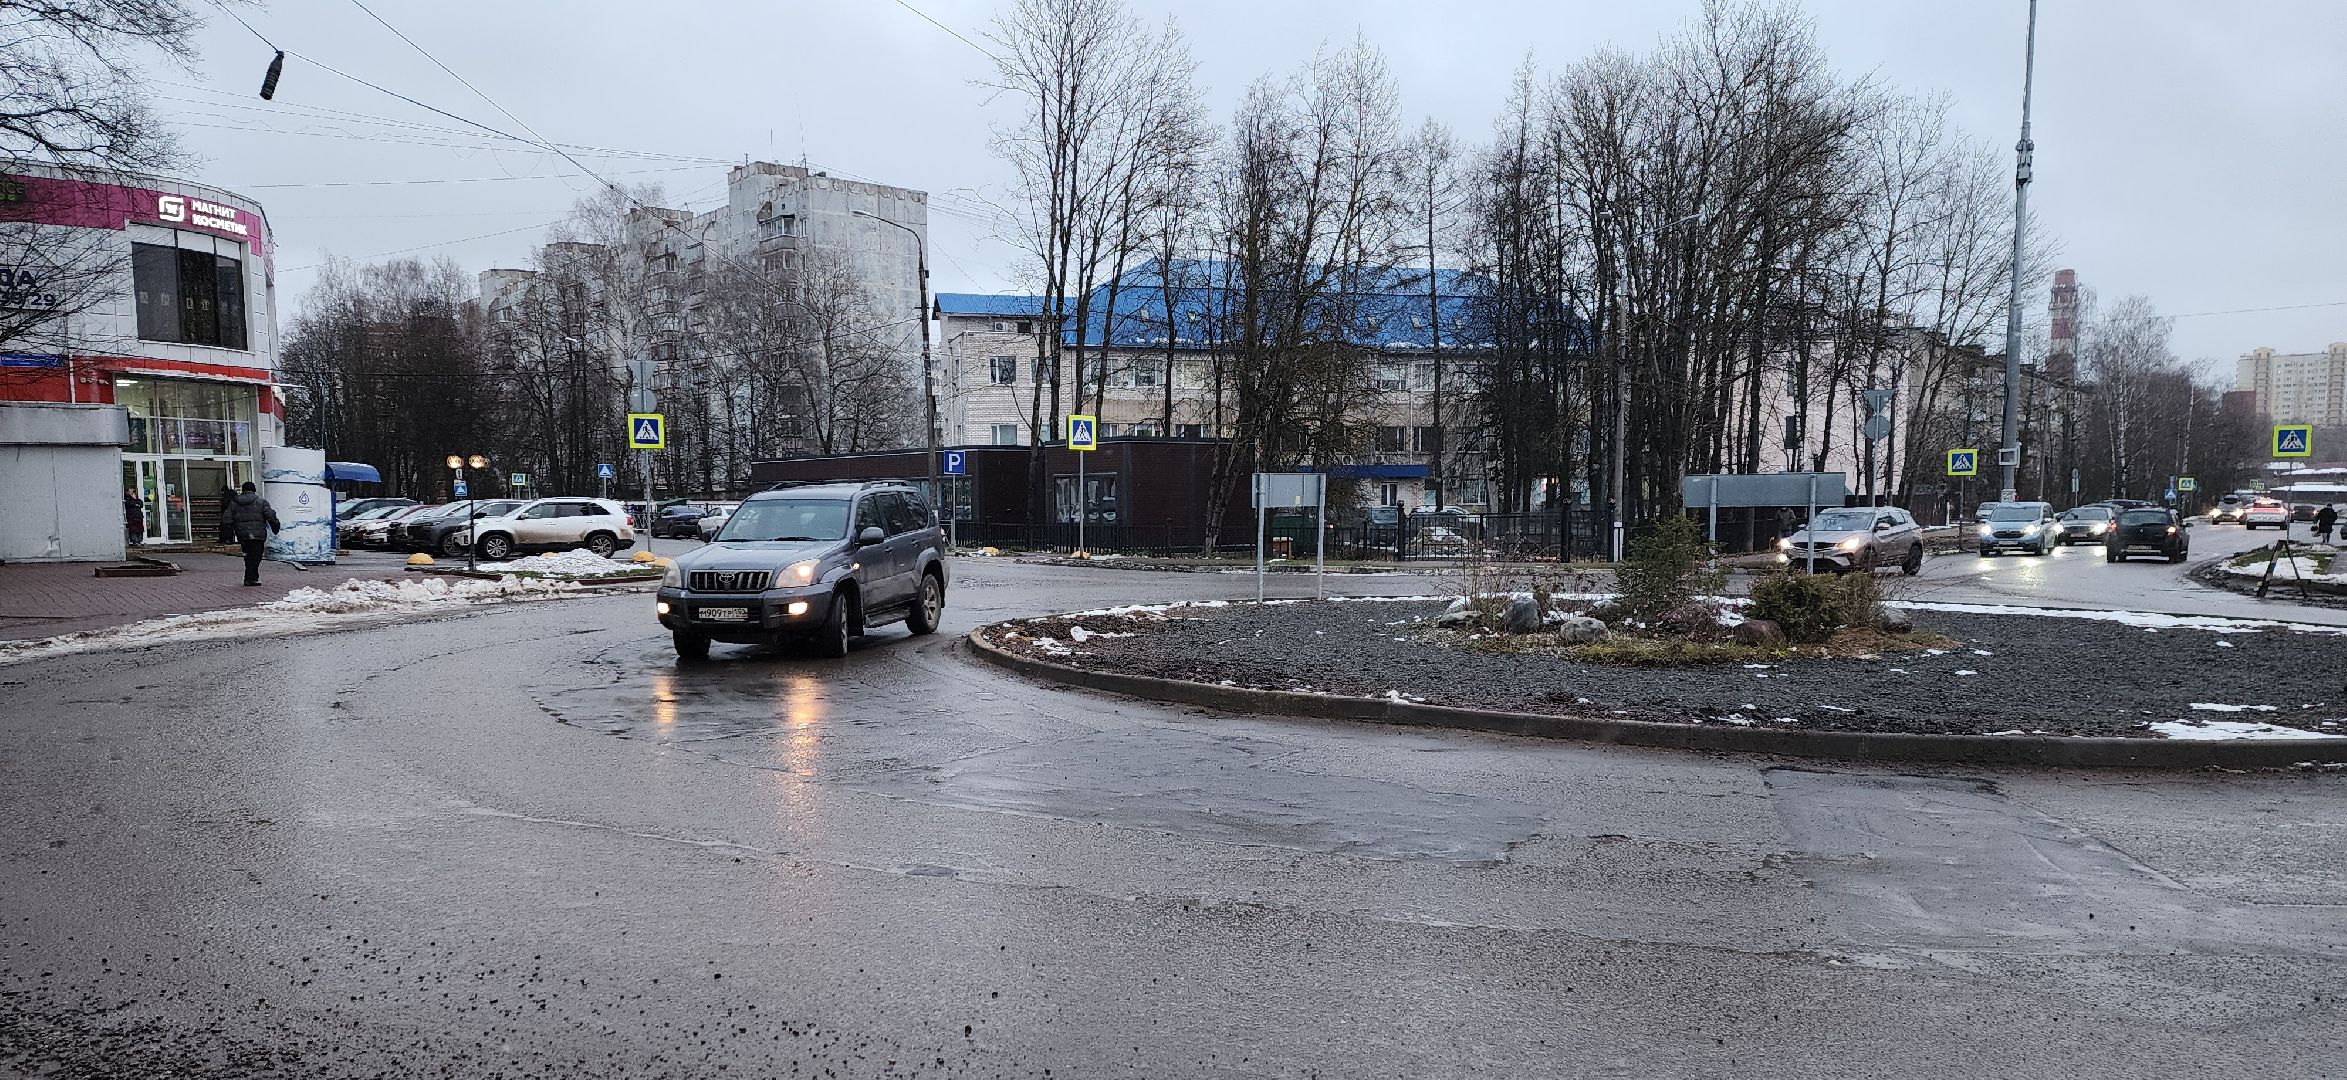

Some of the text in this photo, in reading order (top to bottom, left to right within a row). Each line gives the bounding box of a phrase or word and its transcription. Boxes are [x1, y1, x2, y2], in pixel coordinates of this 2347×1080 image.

[191, 199, 236, 219] МАГНИТ
[191, 213, 248, 235] КОСМЕТИК
[948, 453, 961, 472] P
